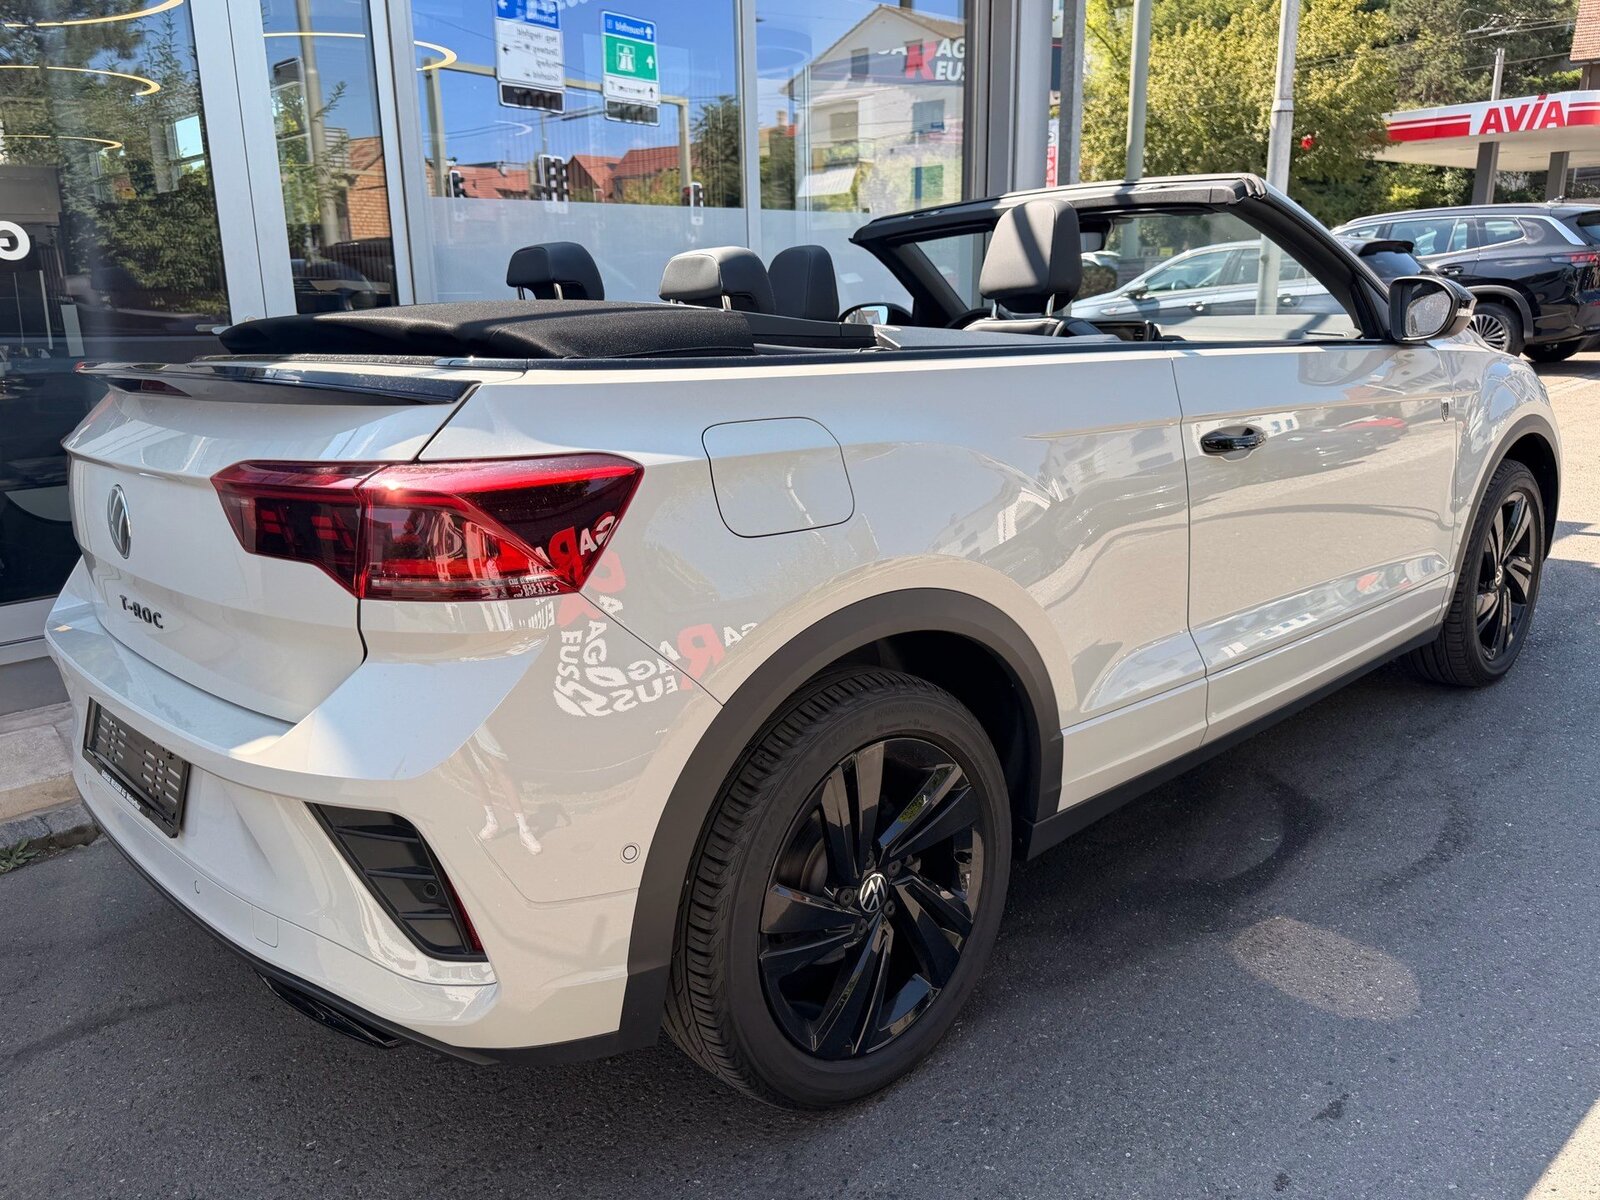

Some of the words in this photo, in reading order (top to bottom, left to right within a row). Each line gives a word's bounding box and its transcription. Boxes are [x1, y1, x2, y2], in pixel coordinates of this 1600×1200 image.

[935, 60, 965, 80] EU
[1479, 93, 1566, 134] AVIA
[119, 594, 164, 629] T-ROC
